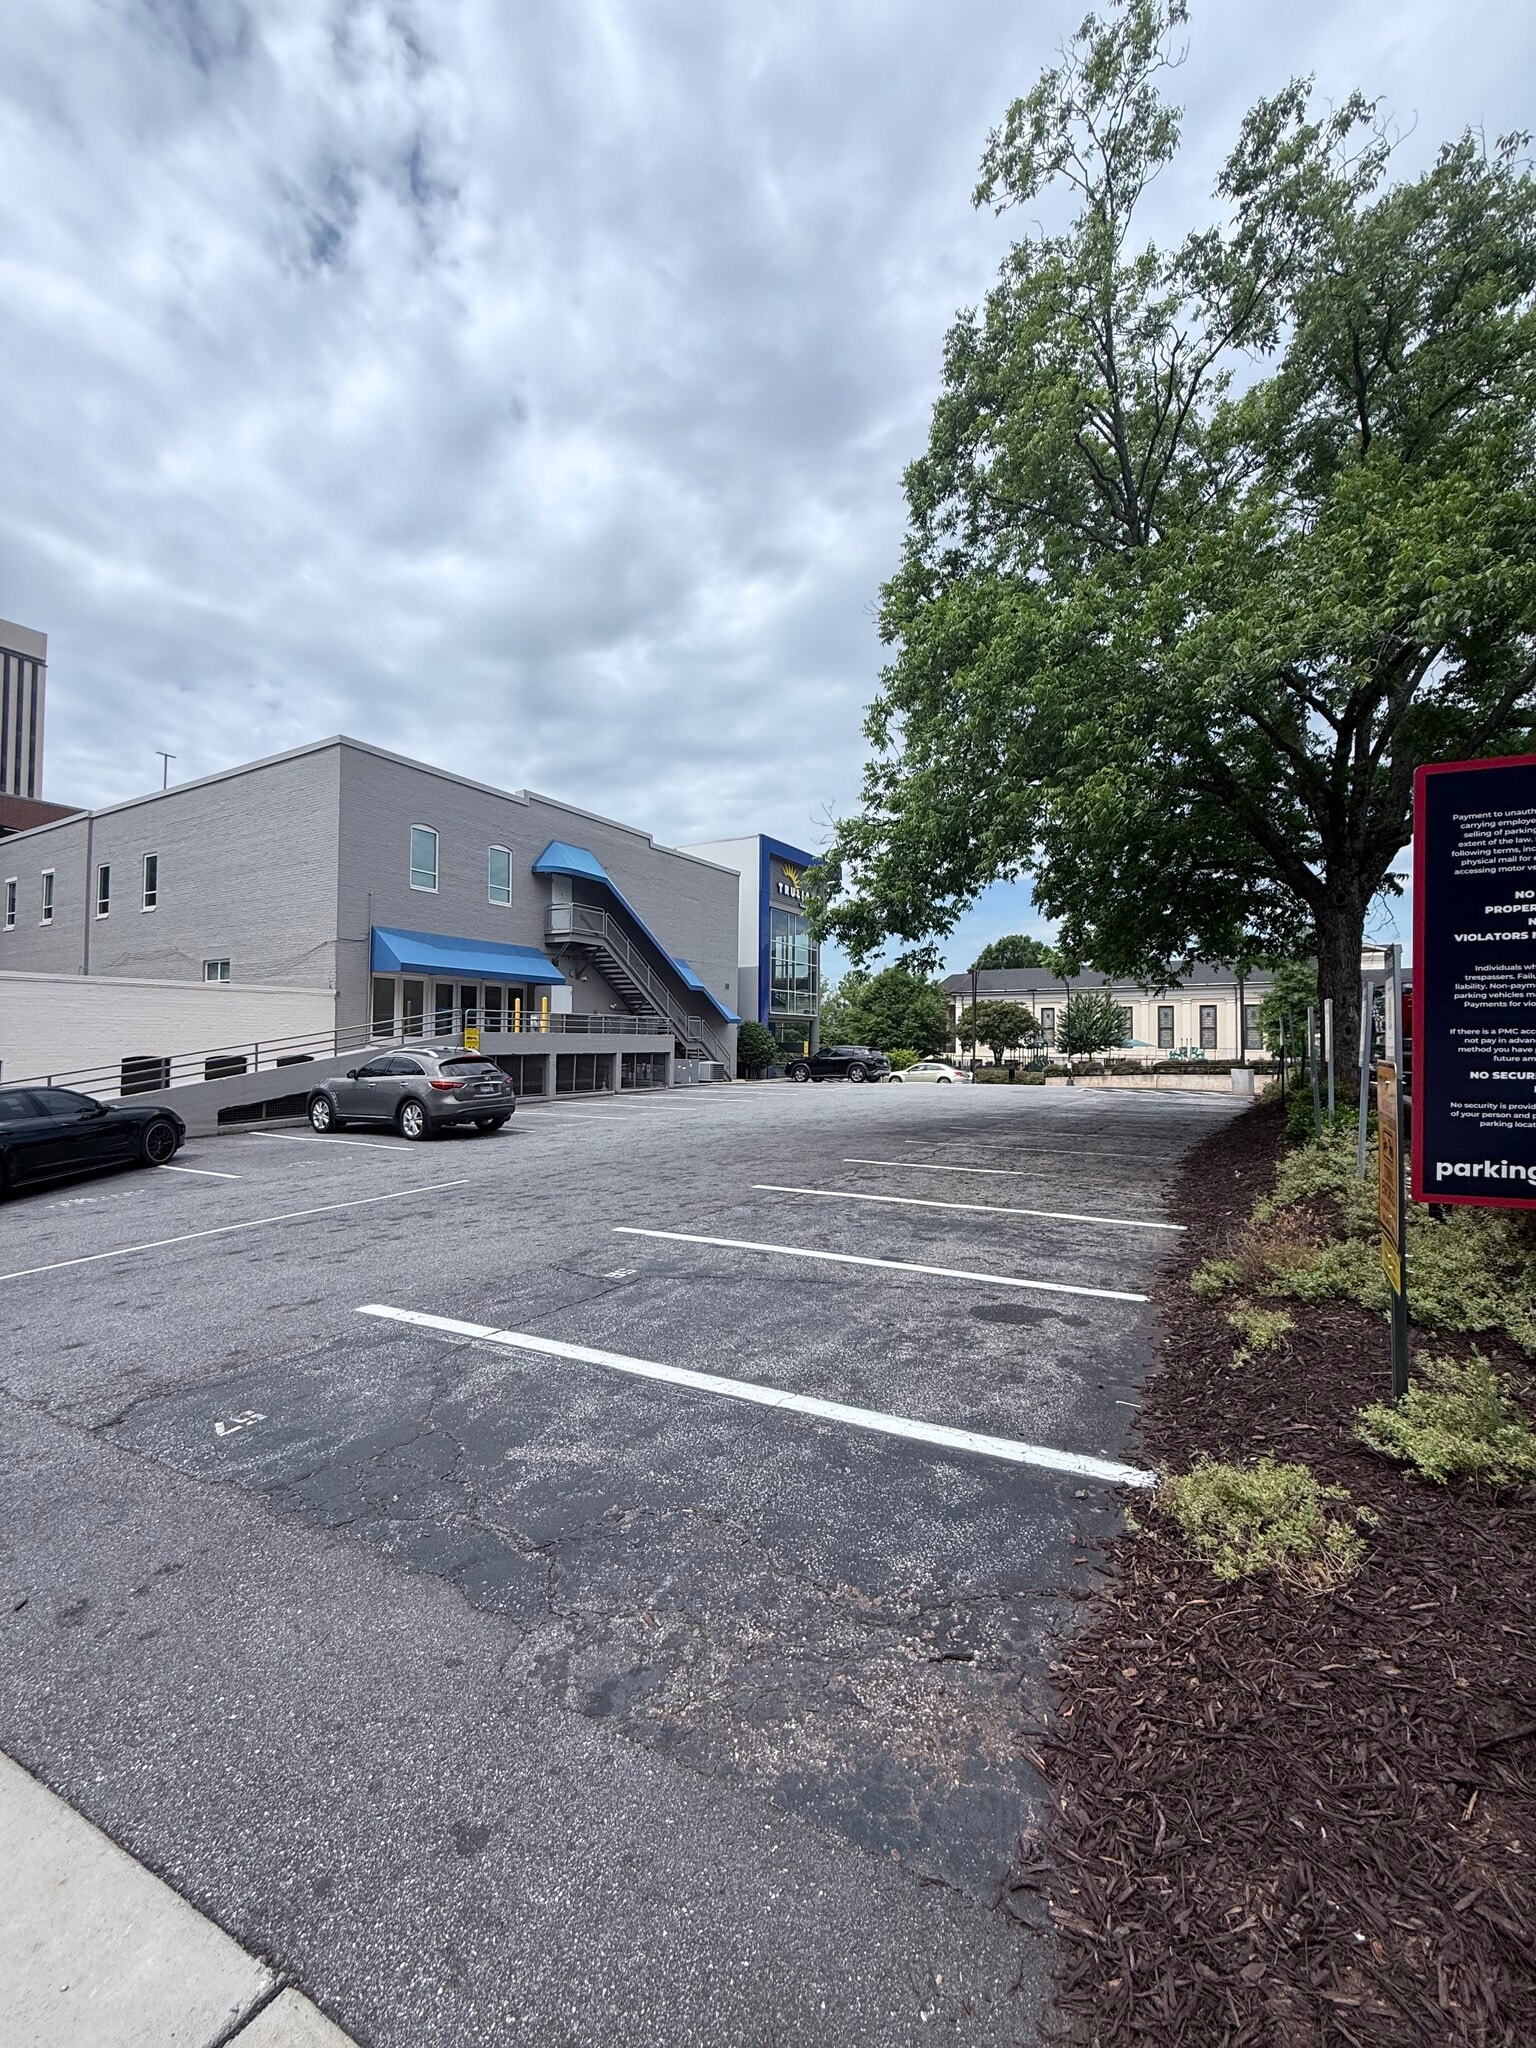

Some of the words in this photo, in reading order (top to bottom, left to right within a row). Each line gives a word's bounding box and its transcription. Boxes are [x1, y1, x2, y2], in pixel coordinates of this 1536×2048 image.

[1452, 812, 1492, 821] Payment
[1460, 821, 1496, 829] carrying
[1463, 830, 1492, 838] selling
[1458, 840, 1486, 848] extent
[1488, 838, 1497, 846] of
[1515, 836, 1533, 844] law.
[1451, 849, 1491, 857] following
[1461, 857, 1496, 867] physical
[1498, 855, 1517, 863] mail
[1454, 866, 1496, 875] accessing
[1515, 890, 1535, 899] NO
[1484, 904, 1536, 914] PROPER
[1454, 931, 1529, 942] VIOLATORS
[1455, 983, 1488, 991] liability.
[1454, 992, 1487, 1000] parking
[1464, 1001, 1507, 1009] Payments
[1469, 1071, 1489, 1080] NO
[1464, 1102, 1498, 1110] security
[1480, 1120, 1513, 1129] parking
[1436, 1160, 1536, 1186] parking
